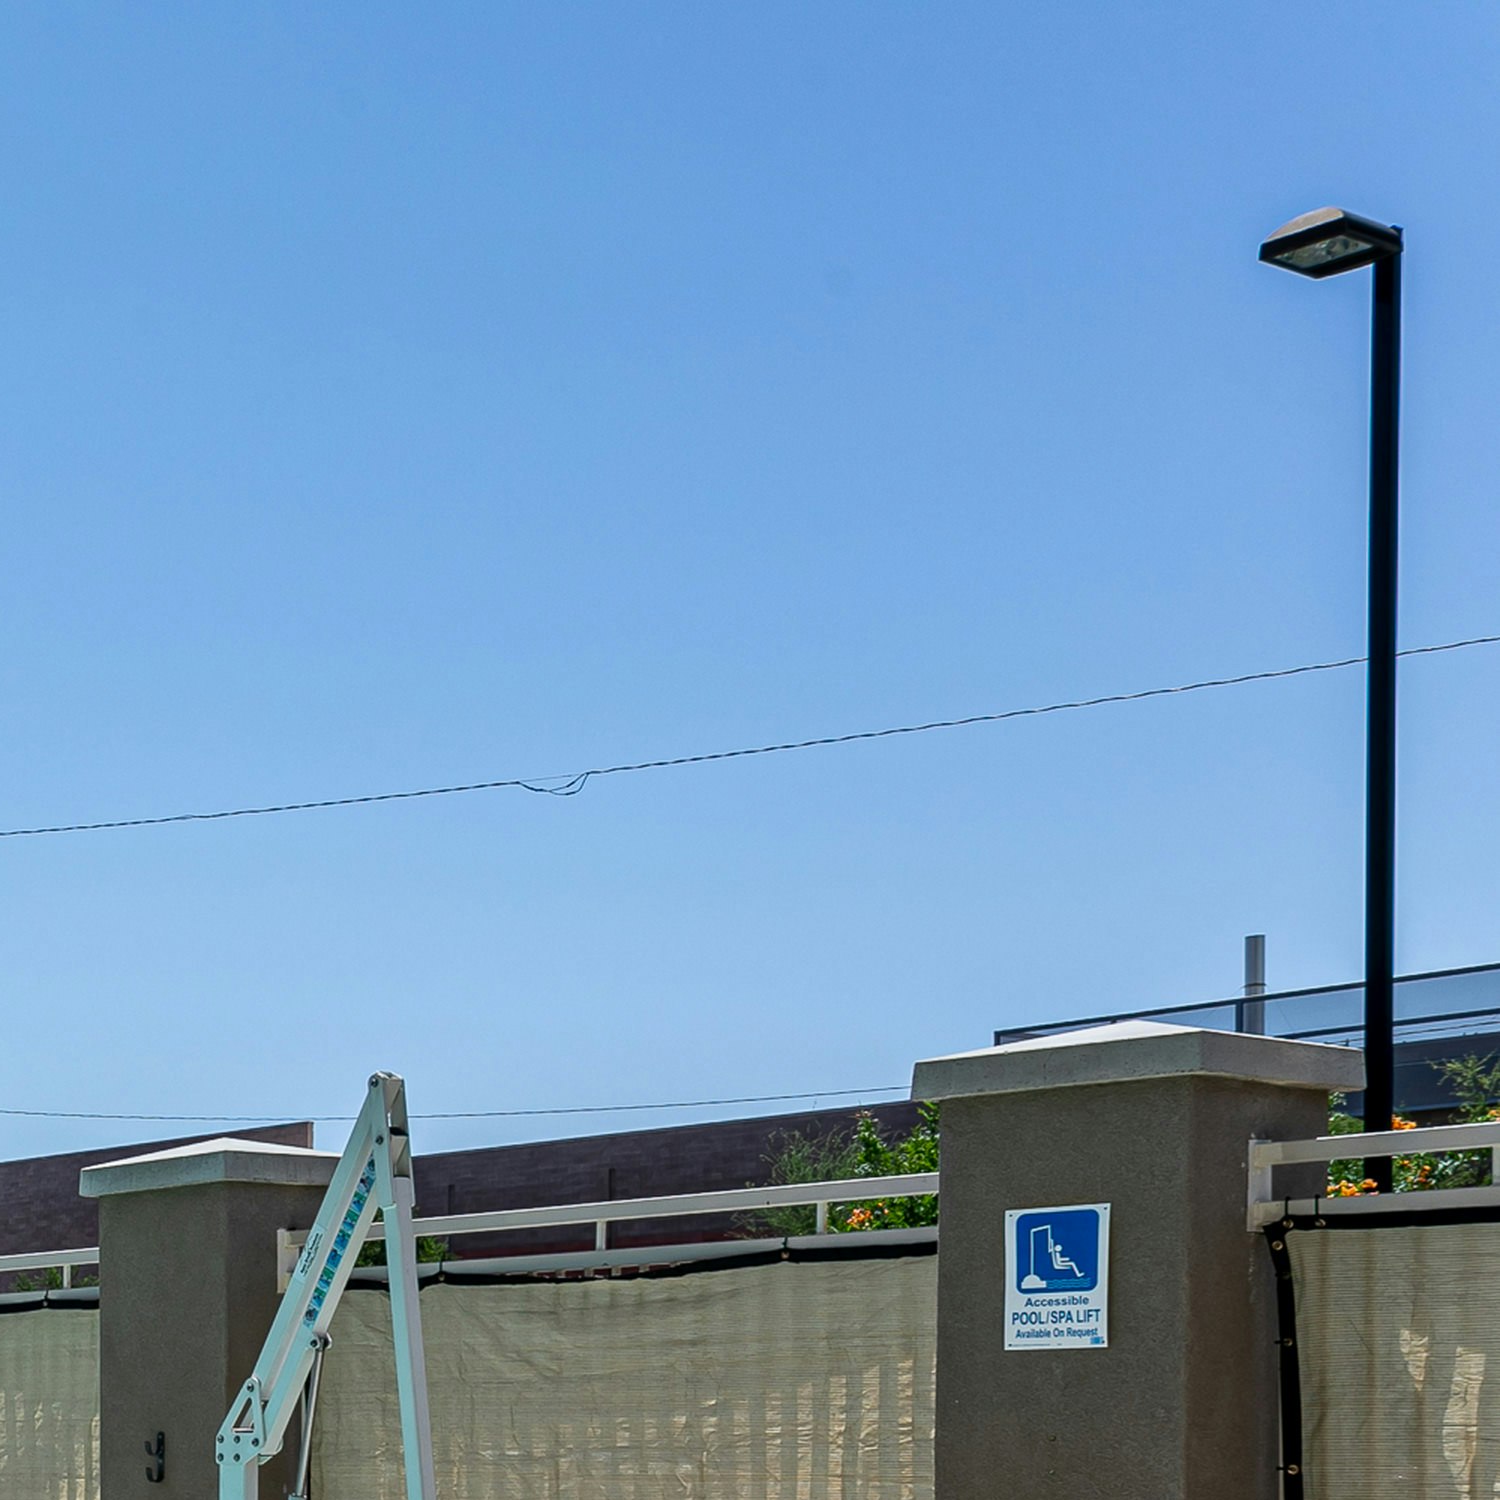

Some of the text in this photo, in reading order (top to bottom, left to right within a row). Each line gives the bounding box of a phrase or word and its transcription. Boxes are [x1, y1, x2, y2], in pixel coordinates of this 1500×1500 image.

[1024, 1296, 1090, 1307] Accessible
[1012, 1308, 1101, 1325] POOL/SPA LIFT
[1015, 1327, 1098, 1339] Available On Request
